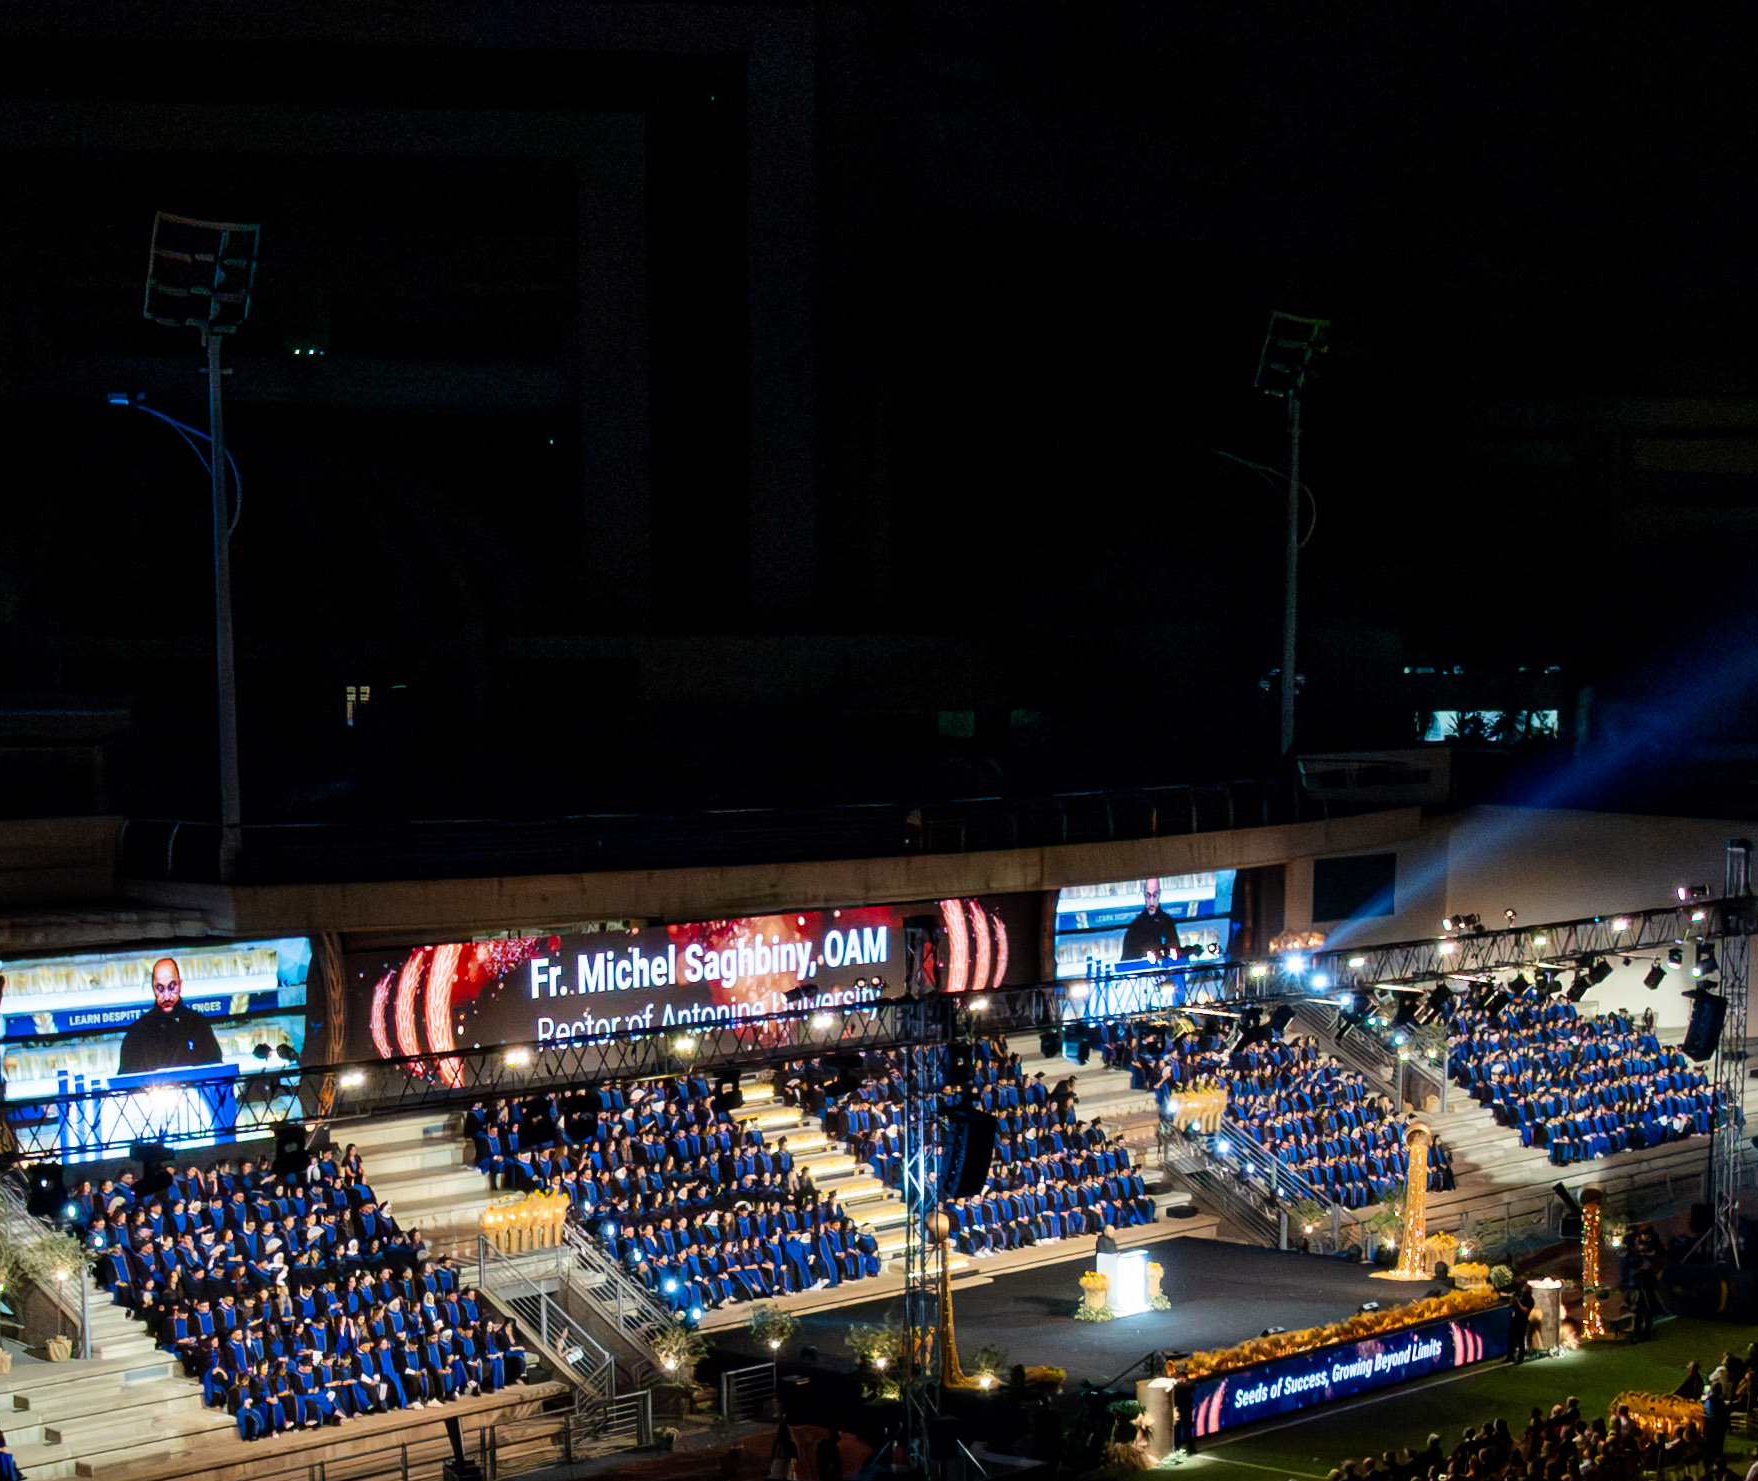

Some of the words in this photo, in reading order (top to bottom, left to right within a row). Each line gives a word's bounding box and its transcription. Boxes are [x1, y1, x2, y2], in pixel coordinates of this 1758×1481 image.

[531, 958, 568, 999] Fr.
[578, 944, 677, 994] Michel
[684, 933, 818, 988] Saghbiny,
[824, 926, 888, 968] OAM
[68, 1013, 101, 1027] LEARN
[537, 1014, 622, 1052] Rector
[628, 1003, 654, 1040] of
[1234, 1385, 1268, 1409] Seeds
[1270, 1377, 1283, 1400] of
[1284, 1370, 1330, 1396] Success,
[1331, 1354, 1373, 1382] Growing
[1374, 1343, 1411, 1374] Beyond
[1411, 1338, 1443, 1362] Limits
